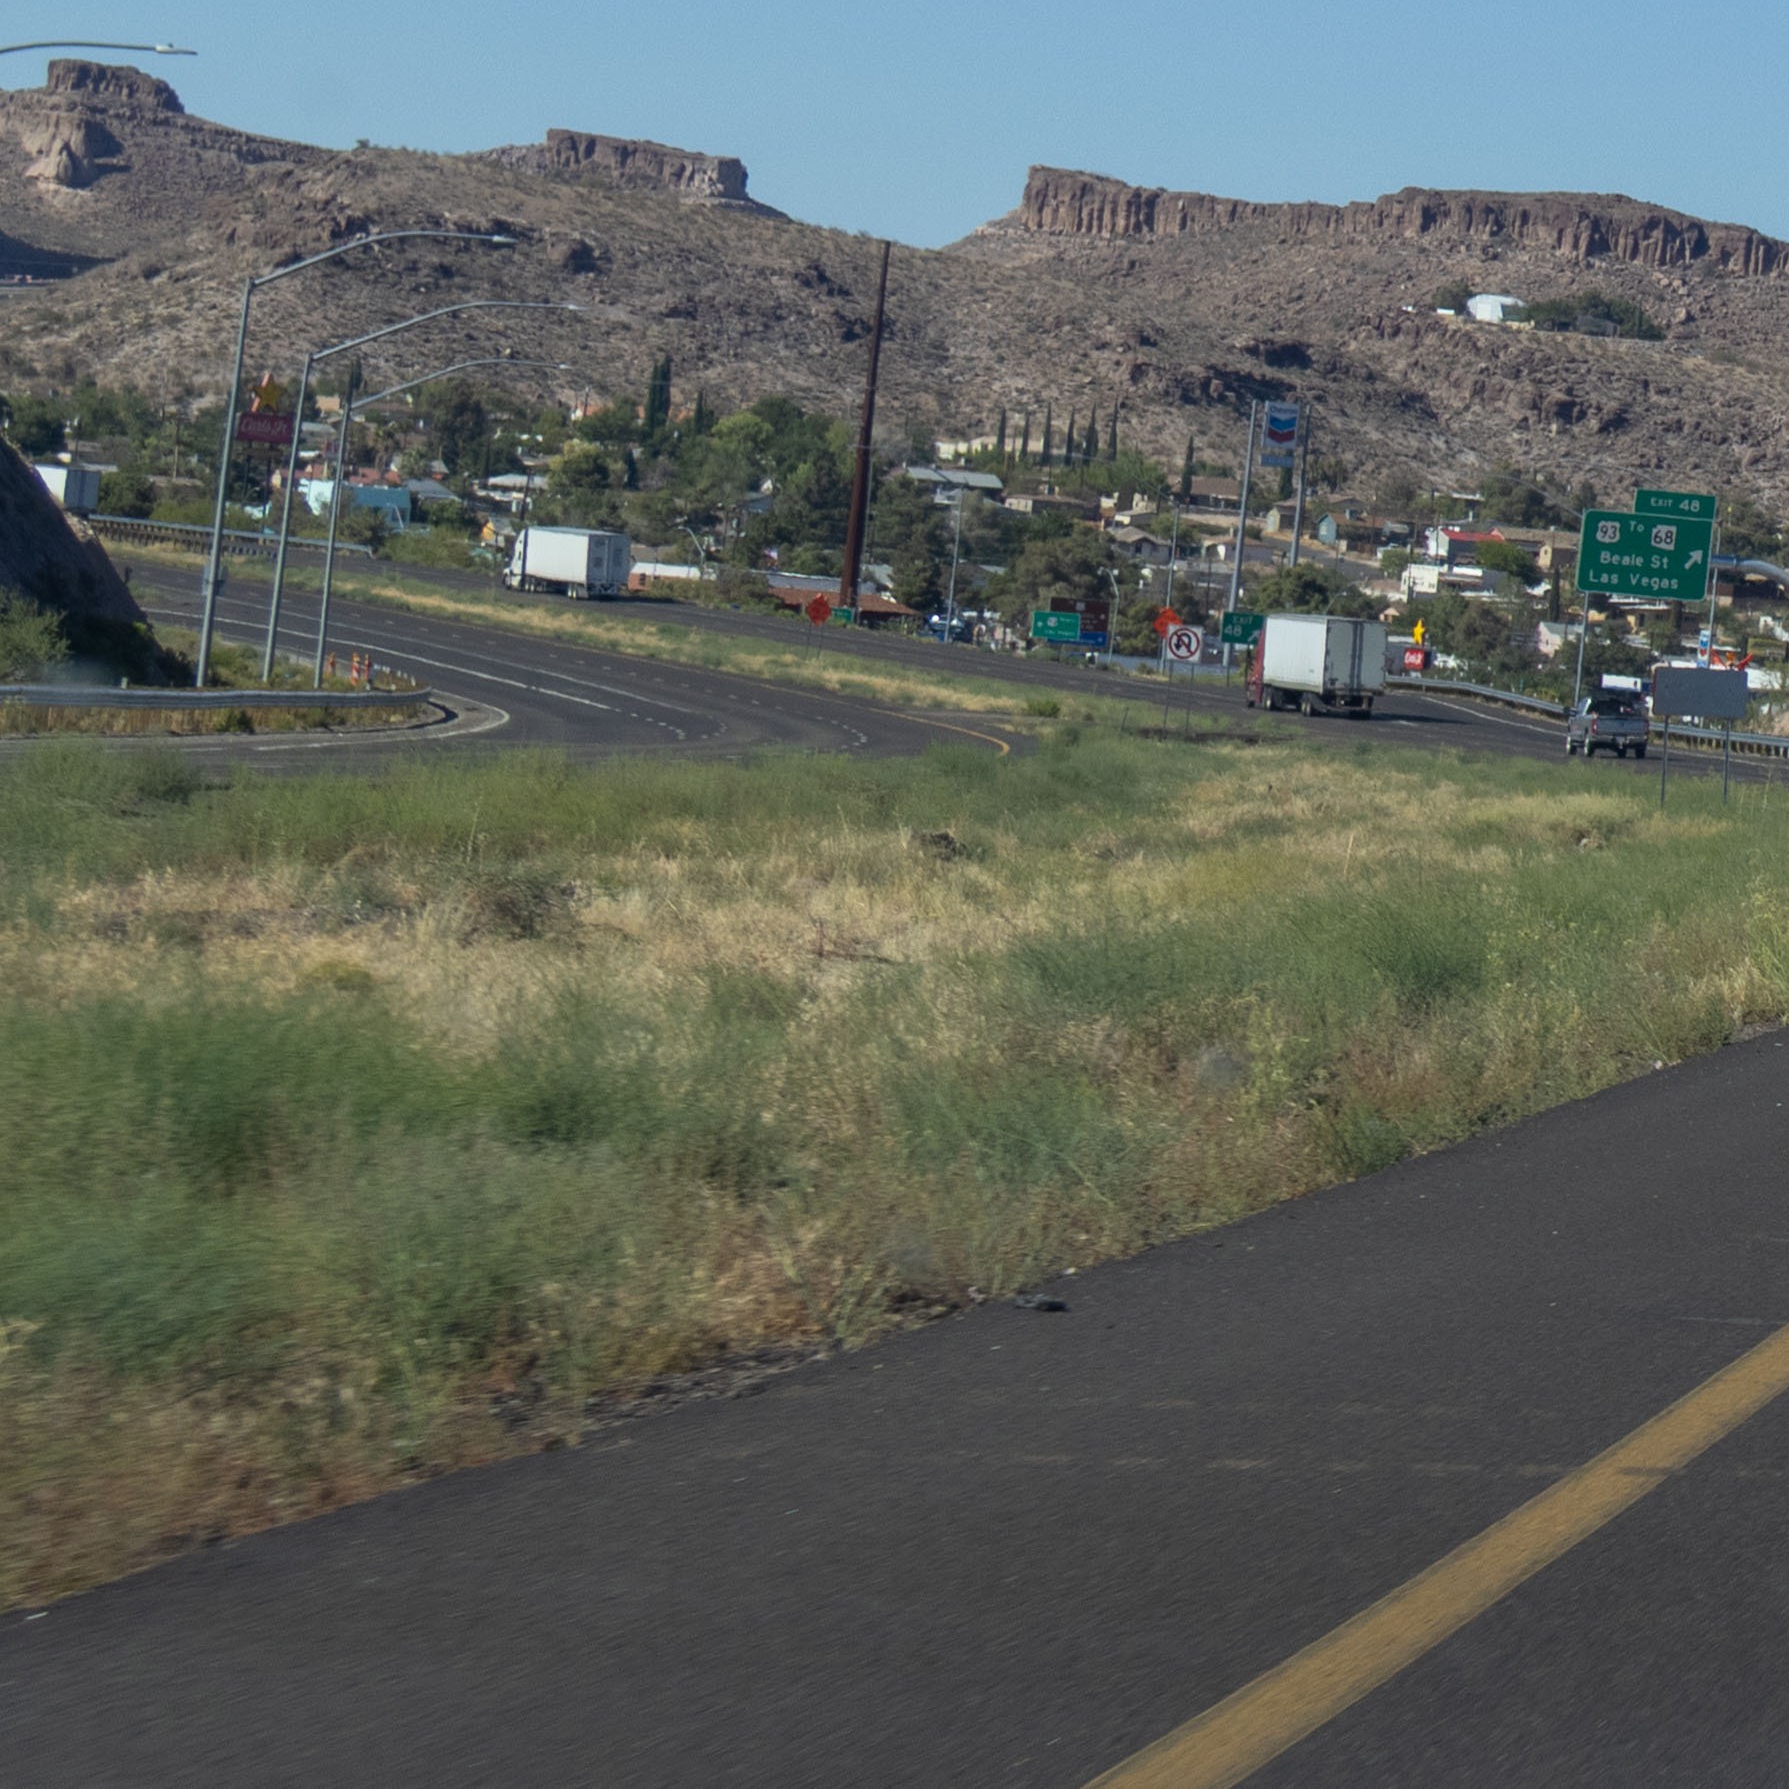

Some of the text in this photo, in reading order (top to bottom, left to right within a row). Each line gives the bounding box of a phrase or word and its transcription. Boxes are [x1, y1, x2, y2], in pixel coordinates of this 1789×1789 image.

[1650, 497, 1700, 512] EXIT 48
[1600, 520, 1674, 545] 93 To 68
[1600, 550, 1669, 569] Beale St
[1589, 569, 1678, 591] Las Vegas
